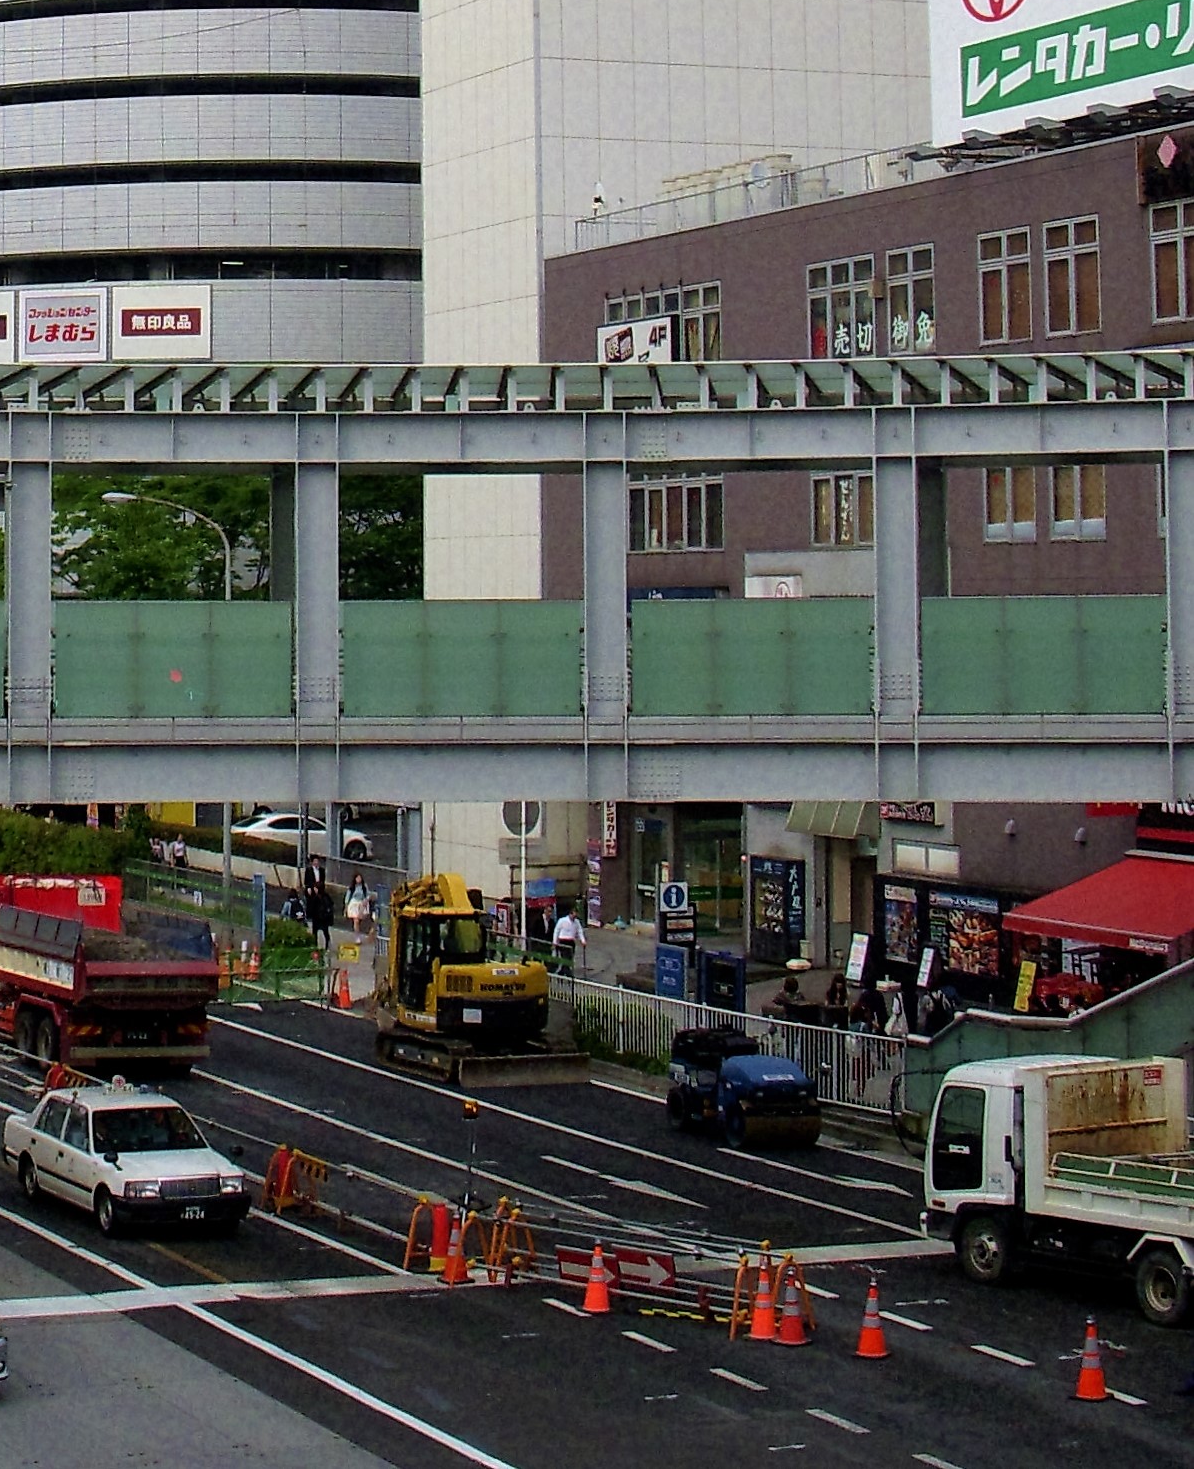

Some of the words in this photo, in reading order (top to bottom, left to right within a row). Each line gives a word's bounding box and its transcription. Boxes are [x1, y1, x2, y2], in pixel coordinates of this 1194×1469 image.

[28, 322, 97, 343] しまむら
[131, 314, 192, 331] 無印良品
[649, 324, 667, 347] 4F
